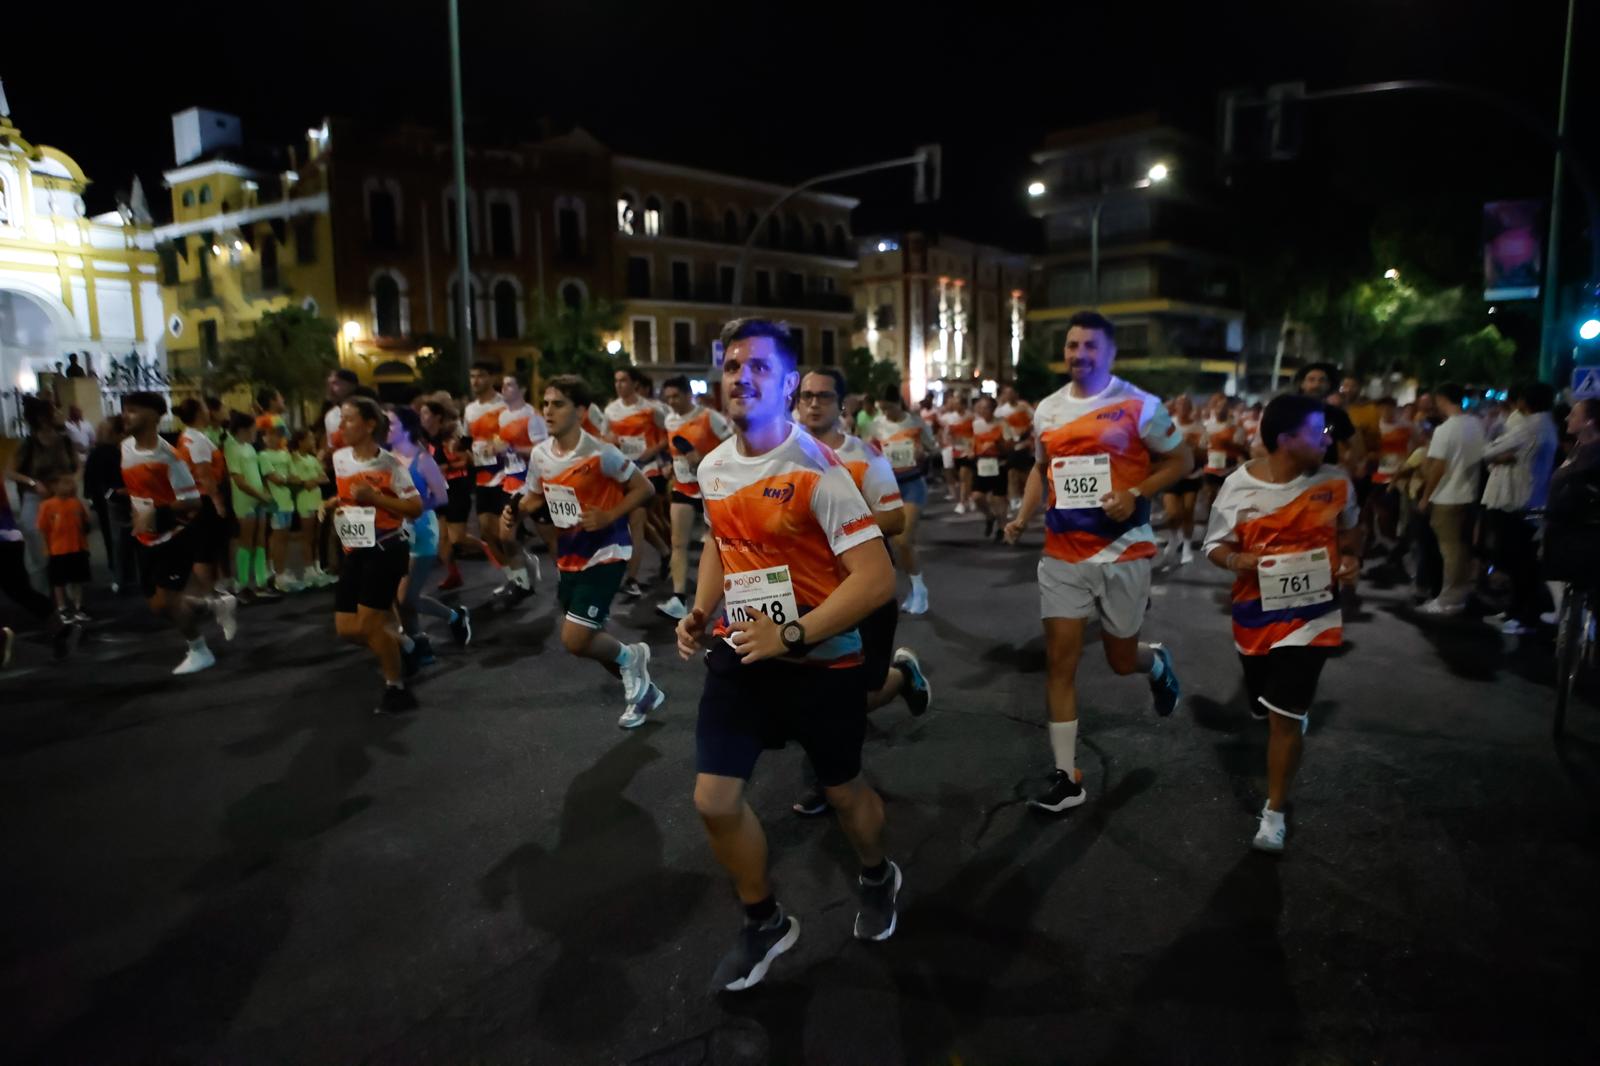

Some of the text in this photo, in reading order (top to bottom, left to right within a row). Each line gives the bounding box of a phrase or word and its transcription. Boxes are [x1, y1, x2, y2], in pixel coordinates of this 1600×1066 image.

[1064, 477, 1098, 494] 4362
[340, 523, 365, 537] 6430
[1279, 575, 1311, 594] 761
